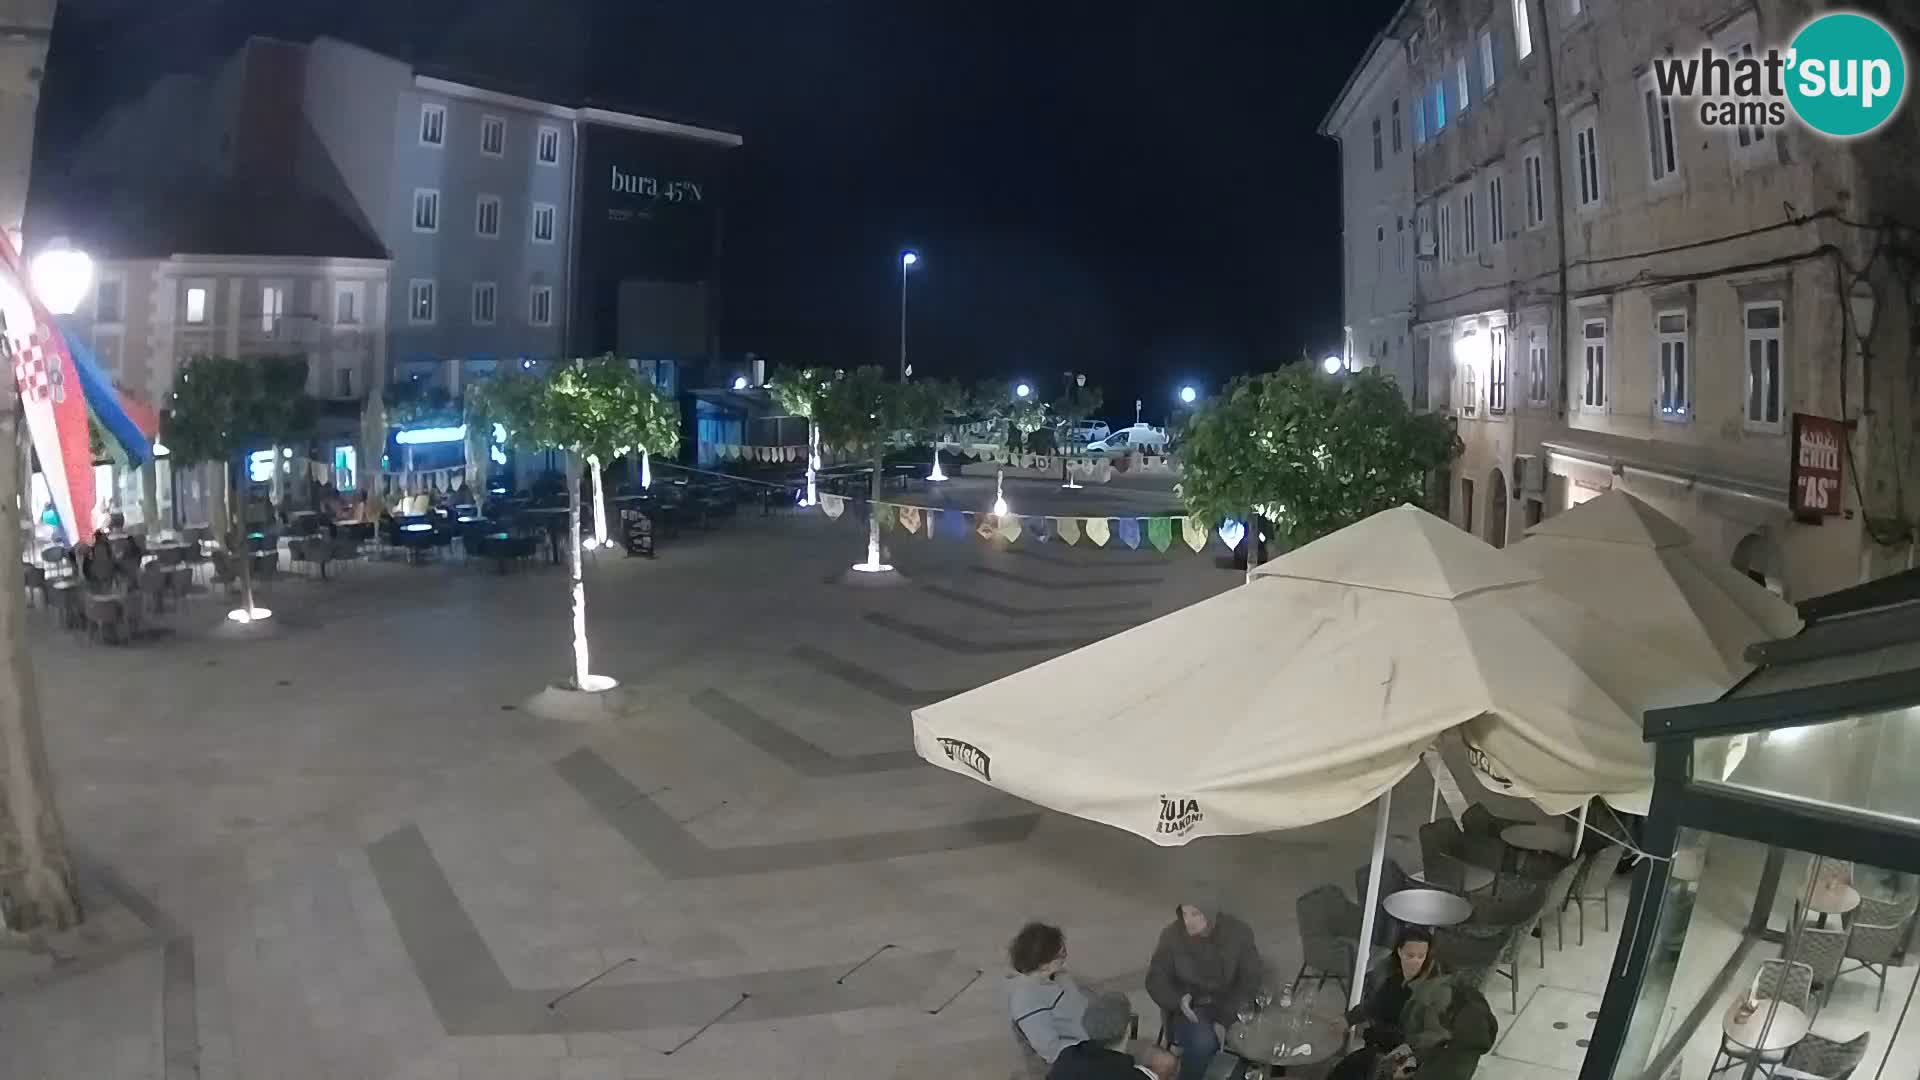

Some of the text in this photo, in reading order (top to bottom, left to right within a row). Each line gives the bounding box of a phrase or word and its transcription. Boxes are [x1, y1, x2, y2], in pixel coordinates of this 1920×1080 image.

[611, 165, 657, 196] bura
[1798, 475, 1839, 509] "AS"
[1160, 794, 1199, 821] ŽUJA
